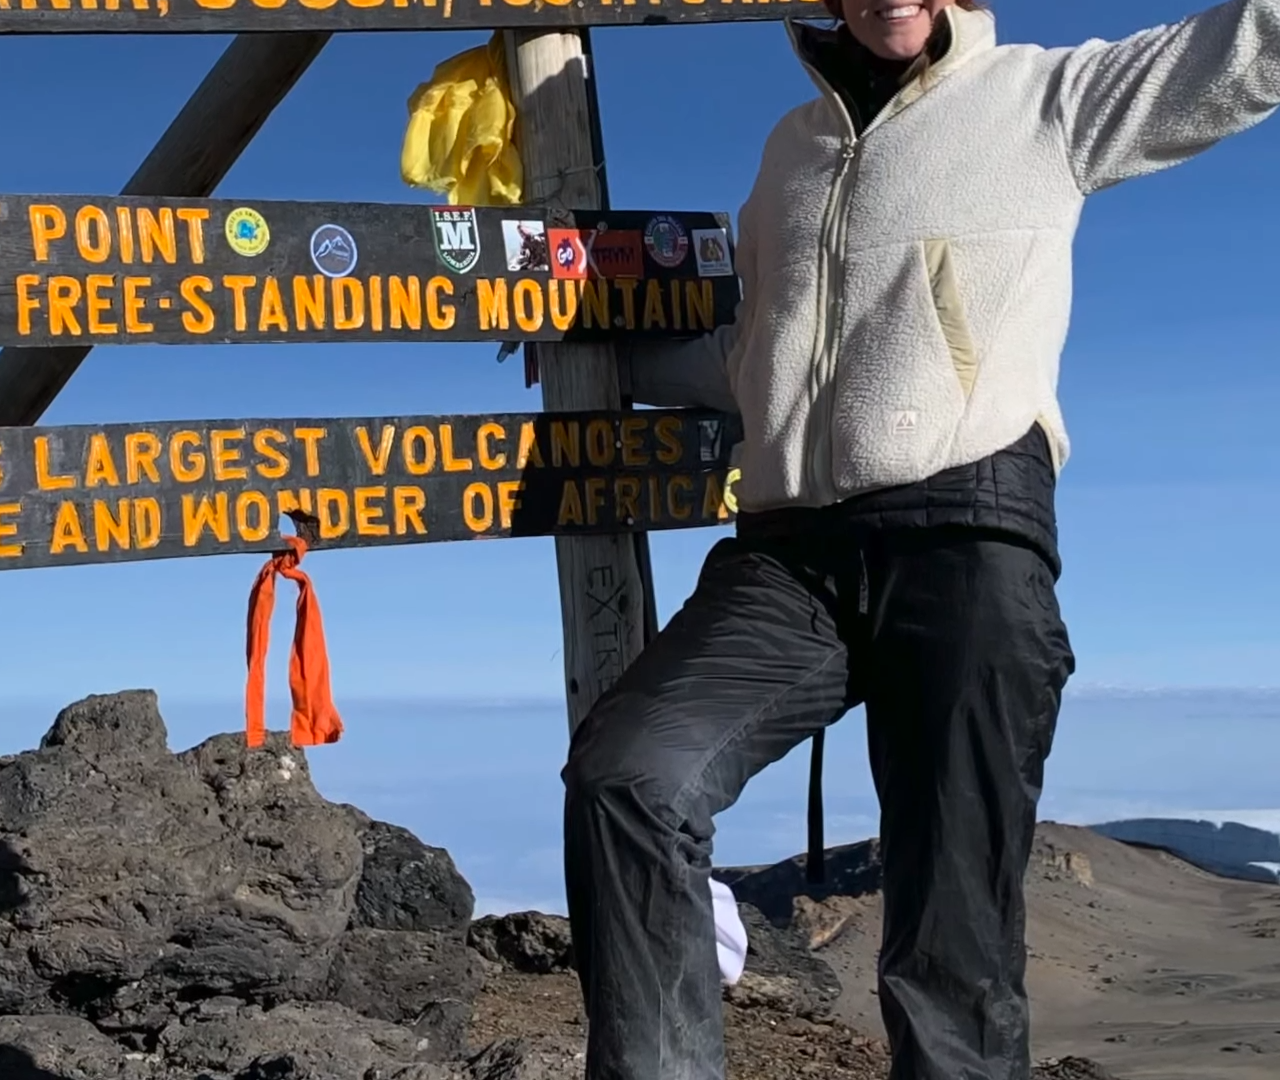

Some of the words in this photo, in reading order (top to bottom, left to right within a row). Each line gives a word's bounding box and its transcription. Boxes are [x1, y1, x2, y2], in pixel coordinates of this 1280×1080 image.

[29, 205, 209, 263] POINT
[436, 221, 476, 250] M
[473, 277, 712, 333] MOUNTAIN
[35, 428, 325, 490] LARGEST
[356, 421, 677, 477] VOLCANOES
[51, 498, 160, 553] AND
[461, 480, 525, 534] OF
[560, 476, 730, 522] AFRICA
